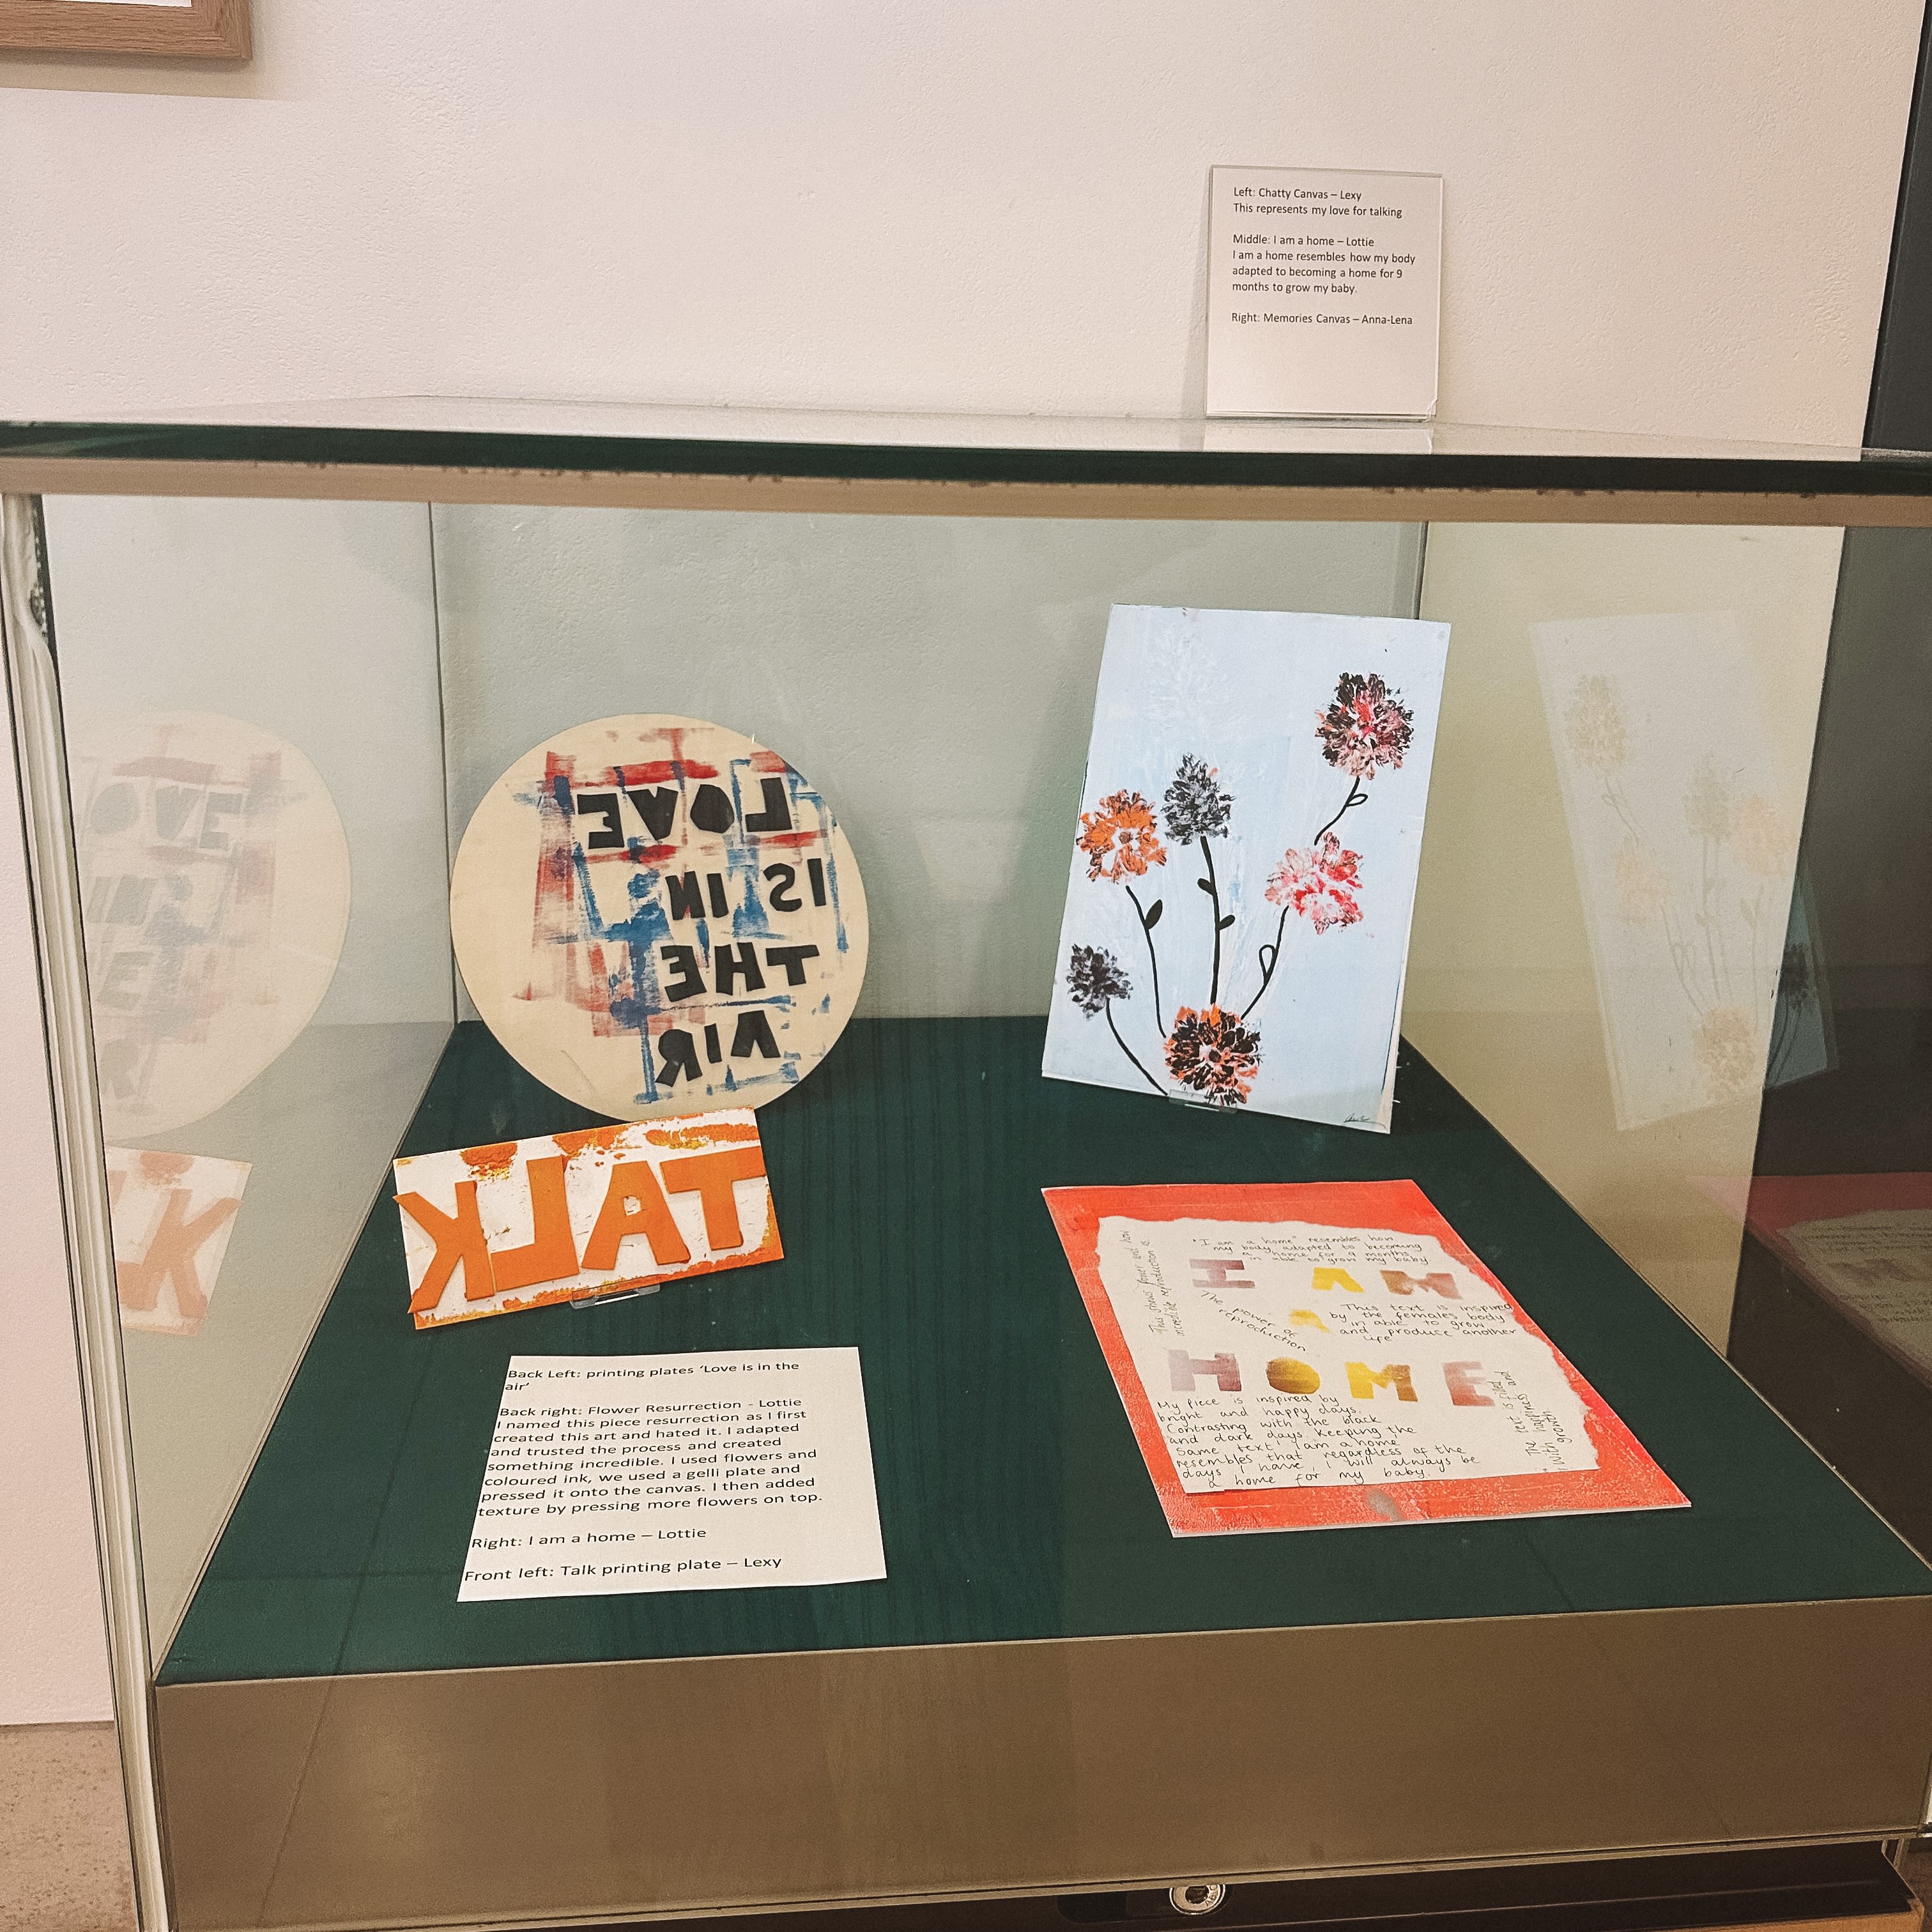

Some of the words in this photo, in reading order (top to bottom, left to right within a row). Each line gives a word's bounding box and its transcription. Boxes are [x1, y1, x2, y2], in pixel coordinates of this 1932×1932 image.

[1234, 187, 1255, 197] Left:
[1259, 188, 1291, 200] Chatty
[1294, 189, 1328, 199] Canvas
[1340, 190, 1361, 202] Lexy
[1233, 203, 1253, 213] This
[1257, 206, 1307, 215] represents
[1312, 208, 1326, 217] my
[1330, 205, 1349, 215] love
[1353, 206, 1367, 215] for
[1370, 206, 1402, 218] talking
[1233, 234, 1270, 244] Middle:
[1307, 235, 1334, 245] home
[1347, 237, 1374, 247] Lottie
[1266, 250, 1293, 260] home
[1297, 252, 1346, 261] resembles
[1351, 252, 1371, 262] how
[1374, 256, 1388, 264] my
[1392, 253, 1415, 265] body
[1232, 266, 1273, 277] adapted
[1289, 266, 1337, 279] becoming
[1349, 268, 1376, 277] home
[1380, 268, 1394, 278] for
[1397, 269, 1402, 278] 9
[1232, 282, 1269, 291] months
[1273, 283, 1283, 291] to
[1285, 285, 1310, 294] grow
[1314, 286, 1328, 295] my
[1331, 283, 1357, 295] baby.
[1232, 312, 1260, 324] Right:
[1264, 313, 1312, 323] Memories
[1317, 314, 1350, 323] Canvas
[1361, 315, 1412, 325] Anna-Lena
[1190, 1259, 1255, 1289] I
[1312, 1268, 1462, 1299] AM
[1200, 1290, 1225, 1305] The
[1232, 1308, 1277, 1327] power
[1284, 1328, 1299, 1338] of
[1460, 1303, 1514, 1313] inspired
[587, 1370, 645, 1379] printing
[650, 1368, 693, 1377] plates
[1169, 1349, 1496, 1406] HOME
[541, 1407, 581, 1416] right:
[647, 1401, 740, 1412] Resurrection
[1157, 1401, 1181, 1415] My
[1257, 1395, 1312, 1406] inspired
[1319, 1395, 1339, 1406] by
[1220, 1406, 1248, 1416] and
[1263, 1407, 1310, 1420] happy
[507, 1420, 560, 1429] named
[601, 1419, 640, 1429] piece
[647, 1414, 739, 1425] resurrection
[494, 1433, 553, 1442] created
[622, 1430, 650, 1439] and
[657, 1428, 700, 1438] hated
[737, 1423, 799, 1434] adapted
[491, 1448, 520, 1456] and
[527, 1446, 584, 1455] trusted
[591, 1446, 616, 1454] the
[622, 1445, 680, 1455] process
[688, 1441, 716, 1450] and
[723, 1438, 781, 1448] created
[488, 1462, 573, 1471] something
[581, 1457, 663, 1468] incredible.
[682, 1455, 716, 1464] used
[724, 1453, 782, 1462] flowers
[788, 1449, 816, 1459] and
[484, 1475, 556, 1485] coloured
[564, 1474, 591, 1483] ink,
[629, 1471, 665, 1480] used
[687, 1469, 719, 1480] gelli
[726, 1468, 765, 1478] plate
[772, 1464, 799, 1474] and
[482, 1490, 545, 1503] pressed
[554, 1490, 564, 1498] it
[571, 1489, 608, 1497] onto
[614, 1486, 640, 1495] the
[647, 1485, 705, 1494] canvas.
[723, 1482, 758, 1491] then
[766, 1477, 814, 1488] added
[479, 1507, 540, 1516] texture
[547, 1505, 566, 1515] by
[572, 1501, 640, 1514] pressing
[648, 1501, 690, 1509] more
[697, 1498, 757, 1506] flowers
[790, 1494, 822, 1503] top.
[472, 1538, 521, 1549] Right:
[588, 1533, 635, 1542] home
[659, 1529, 706, 1538] Lottie
[464, 1570, 512, 1581] Front
[519, 1567, 553, 1578] left:
[561, 1565, 596, 1575] Talk
[602, 1563, 671, 1576] printing
[678, 1560, 721, 1572] plate
[745, 1558, 781, 1568] Lexy
